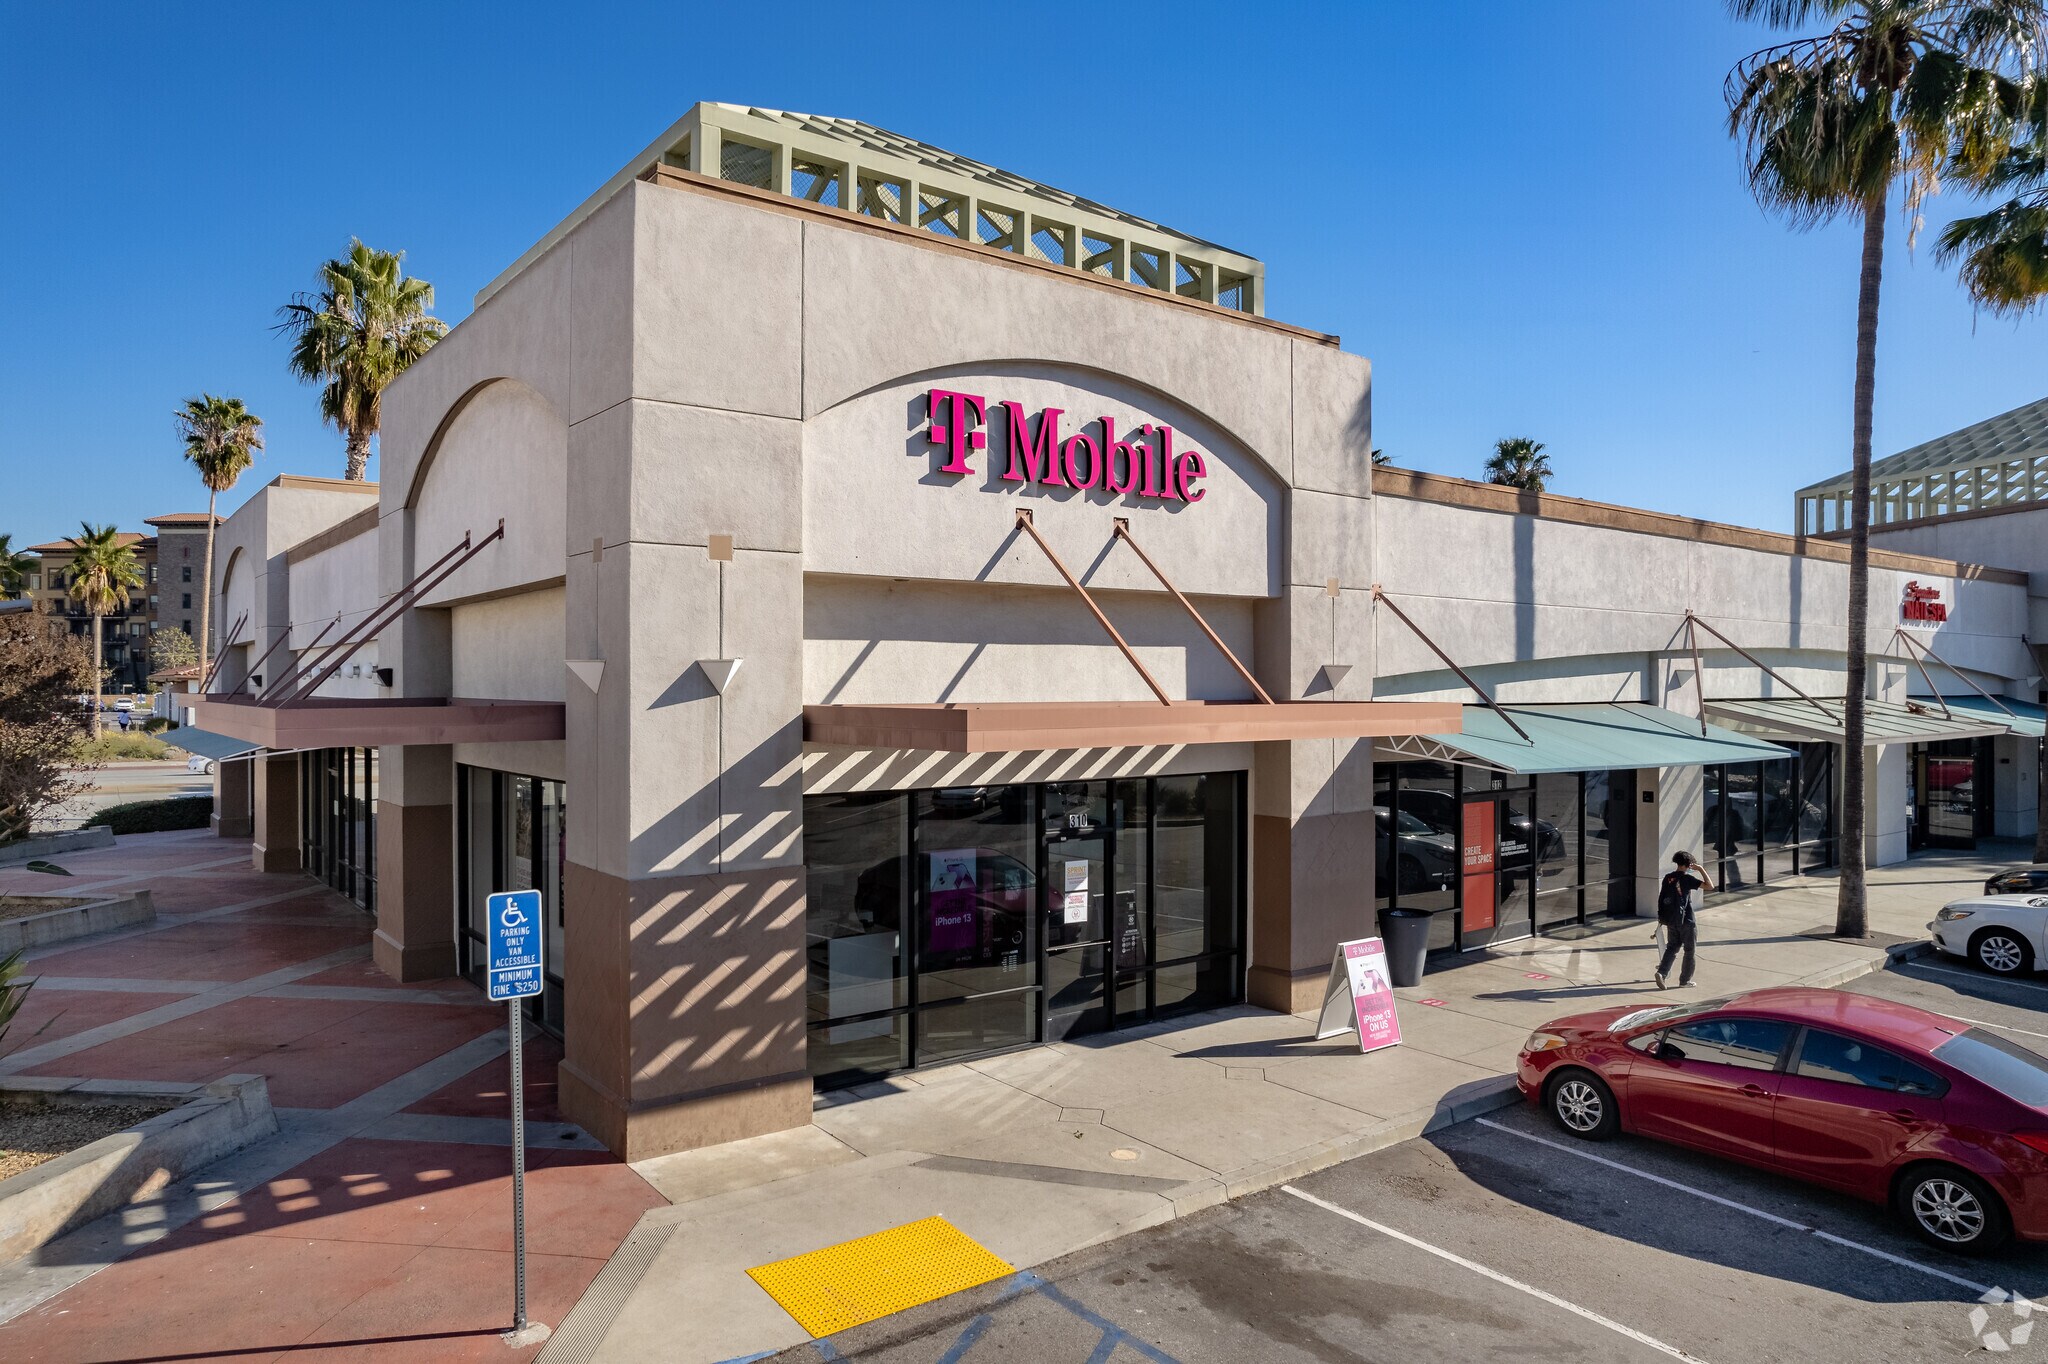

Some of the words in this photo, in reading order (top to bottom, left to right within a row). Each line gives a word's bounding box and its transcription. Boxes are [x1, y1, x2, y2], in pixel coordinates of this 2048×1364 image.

[999, 400, 1207, 503] Mobile
[1904, 600, 1928, 620] NAIL
[1928, 603, 1947, 622] SPA
[1070, 814, 1087, 828] 310
[1465, 845, 1481, 856] CREATE
[1465, 856, 1477, 865] YOUR
[1477, 853, 1492, 864] SPACE
[1067, 866, 1086, 874] SPRINT
[935, 916, 961, 926] iPhone
[963, 913, 972, 922] 13
[500, 926, 530, 938] PARKING
[506, 936, 525, 947] ONLY
[508, 946, 522, 956] VAN
[1358, 944, 1376, 955] Mobile
[495, 954, 536, 967] ACCESSIBLE
[499, 969, 533, 983] MINIMUM
[493, 984, 511, 996] FINE
[516, 980, 539, 994] $250
[1362, 1013, 1384, 1025] iPhone
[1383, 1009, 1391, 1019] 13
[1369, 1022, 1380, 1032] ON
[1379, 1019, 1389, 1029] US
